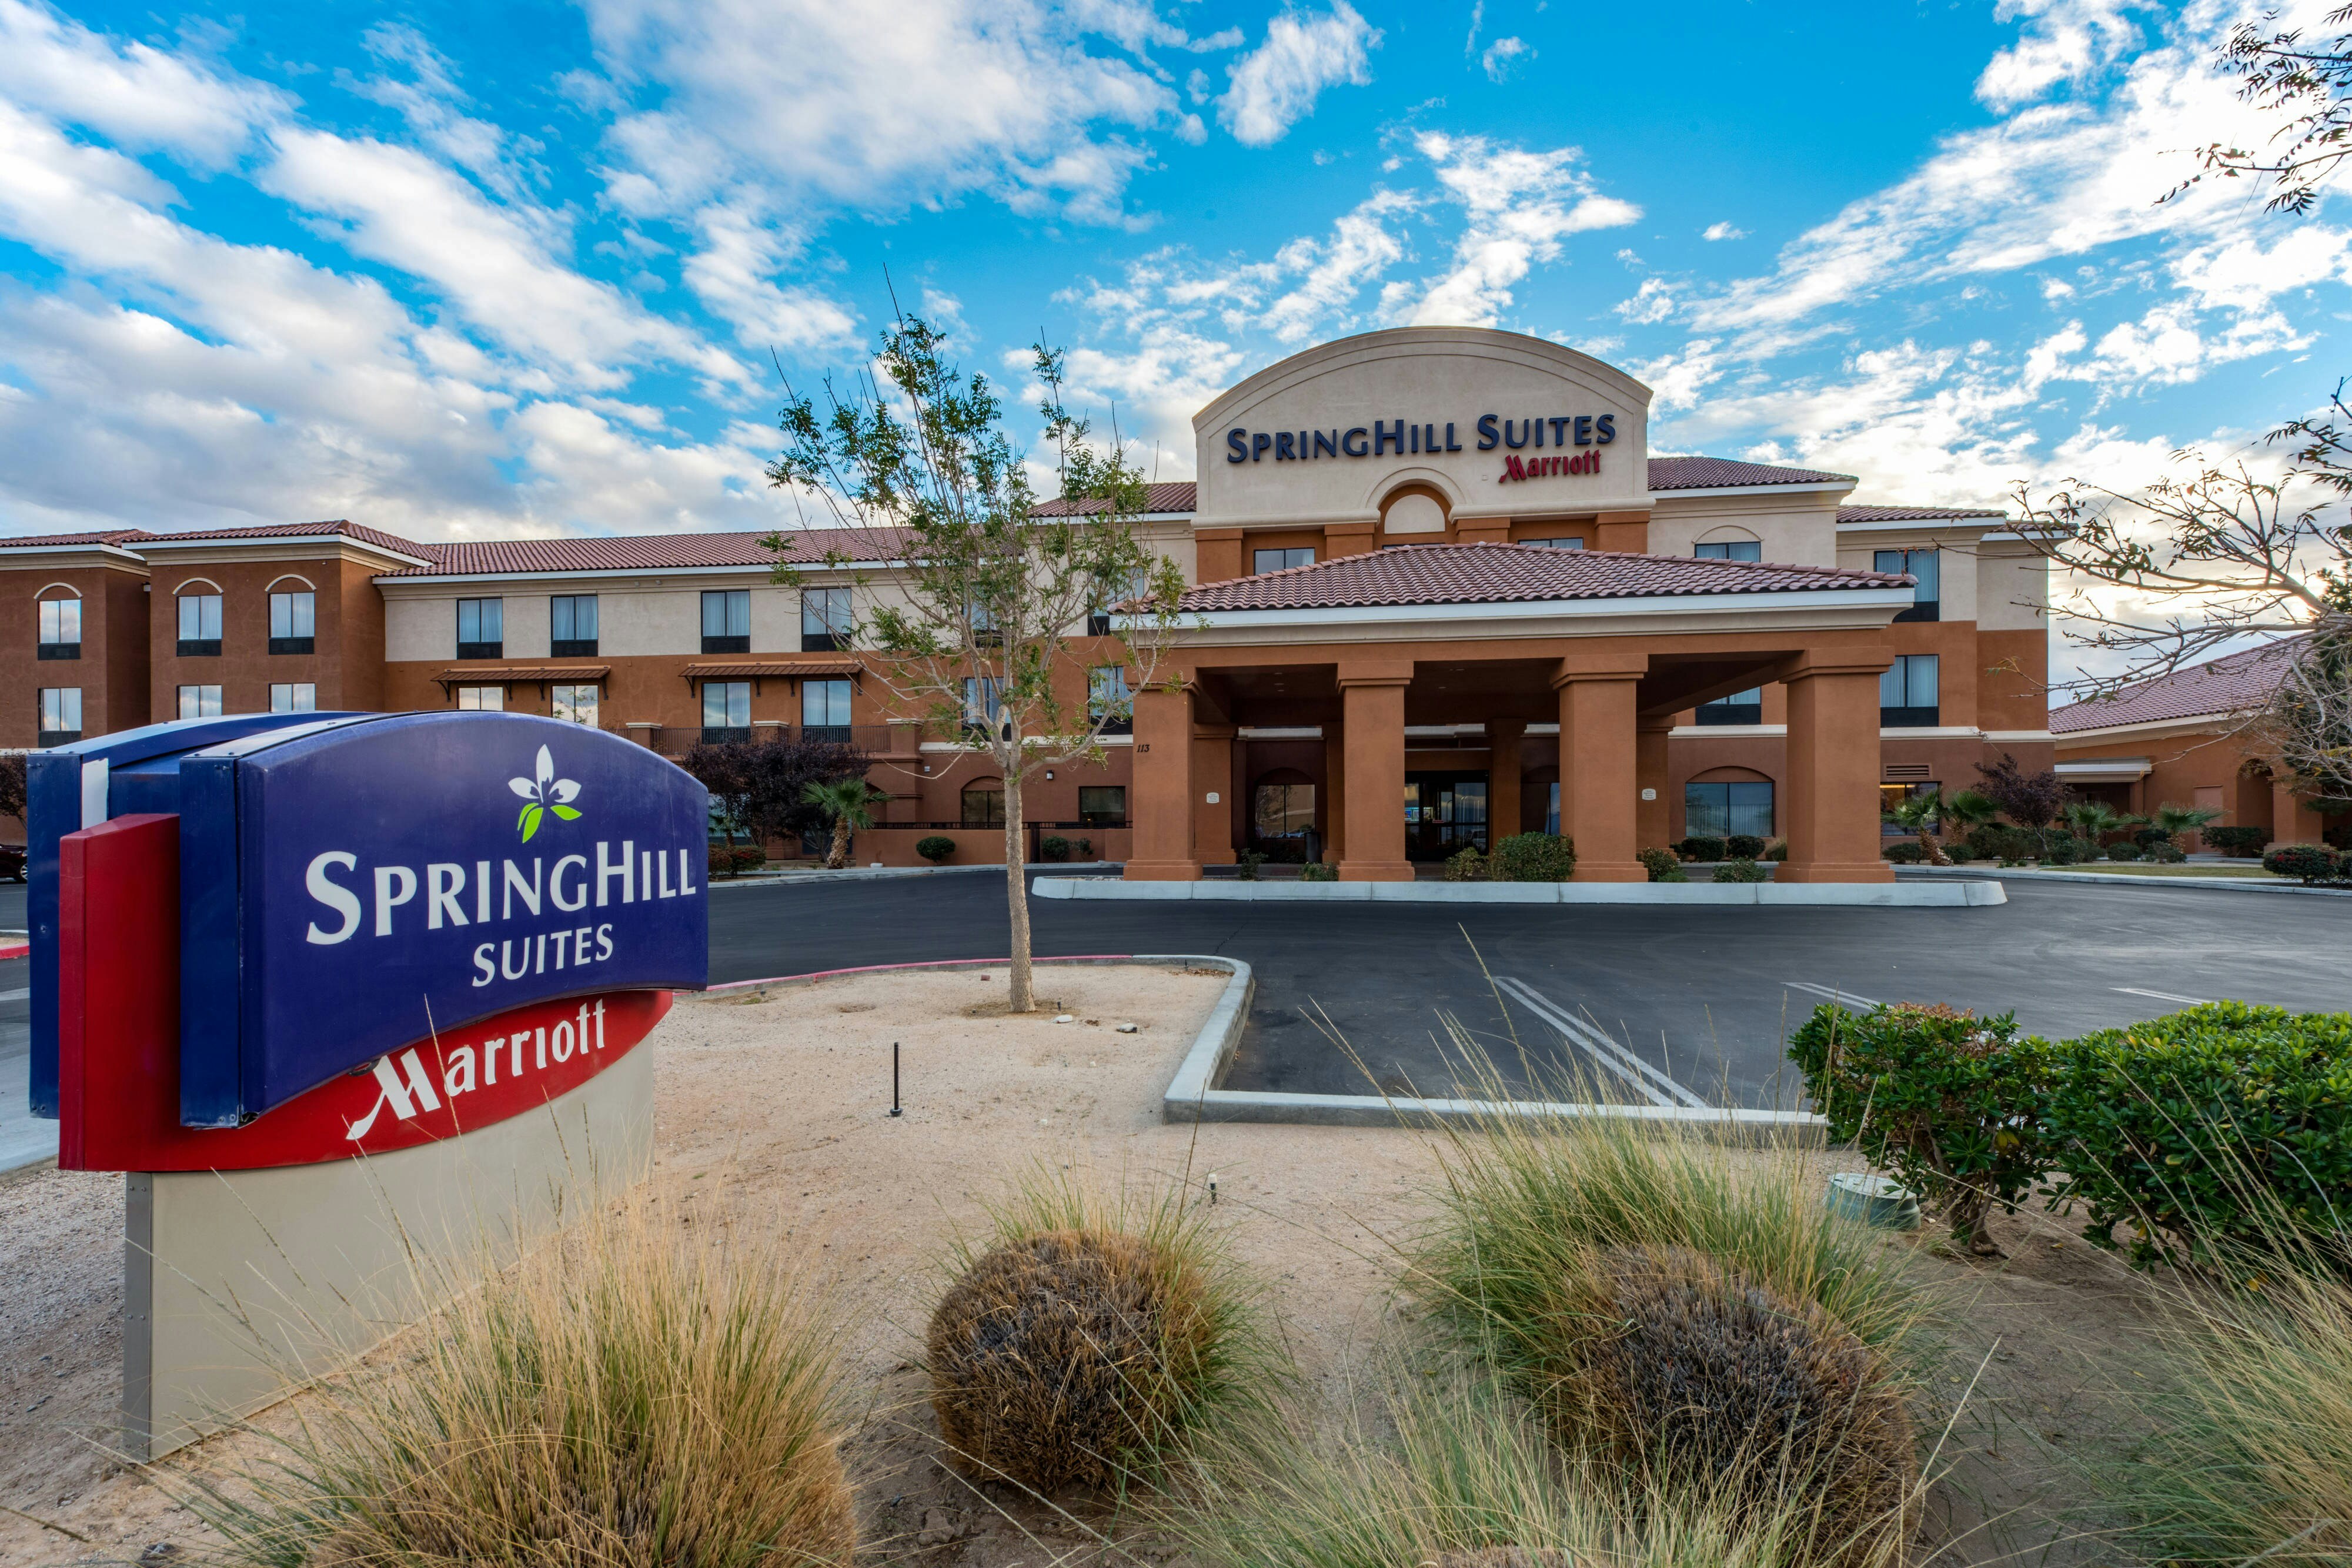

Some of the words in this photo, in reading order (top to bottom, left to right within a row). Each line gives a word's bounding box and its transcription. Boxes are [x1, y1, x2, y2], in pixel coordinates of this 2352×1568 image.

[1227, 419, 1462, 463] SPRINGHILL
[1476, 414, 1616, 450] SUITES
[1499, 449, 1601, 483] Marriott
[1137, 744, 1150, 753] 113
[306, 841, 696, 945] SPRINGHILL
[472, 924, 613, 987] SUITES
[345, 998, 606, 1141] Marriott
